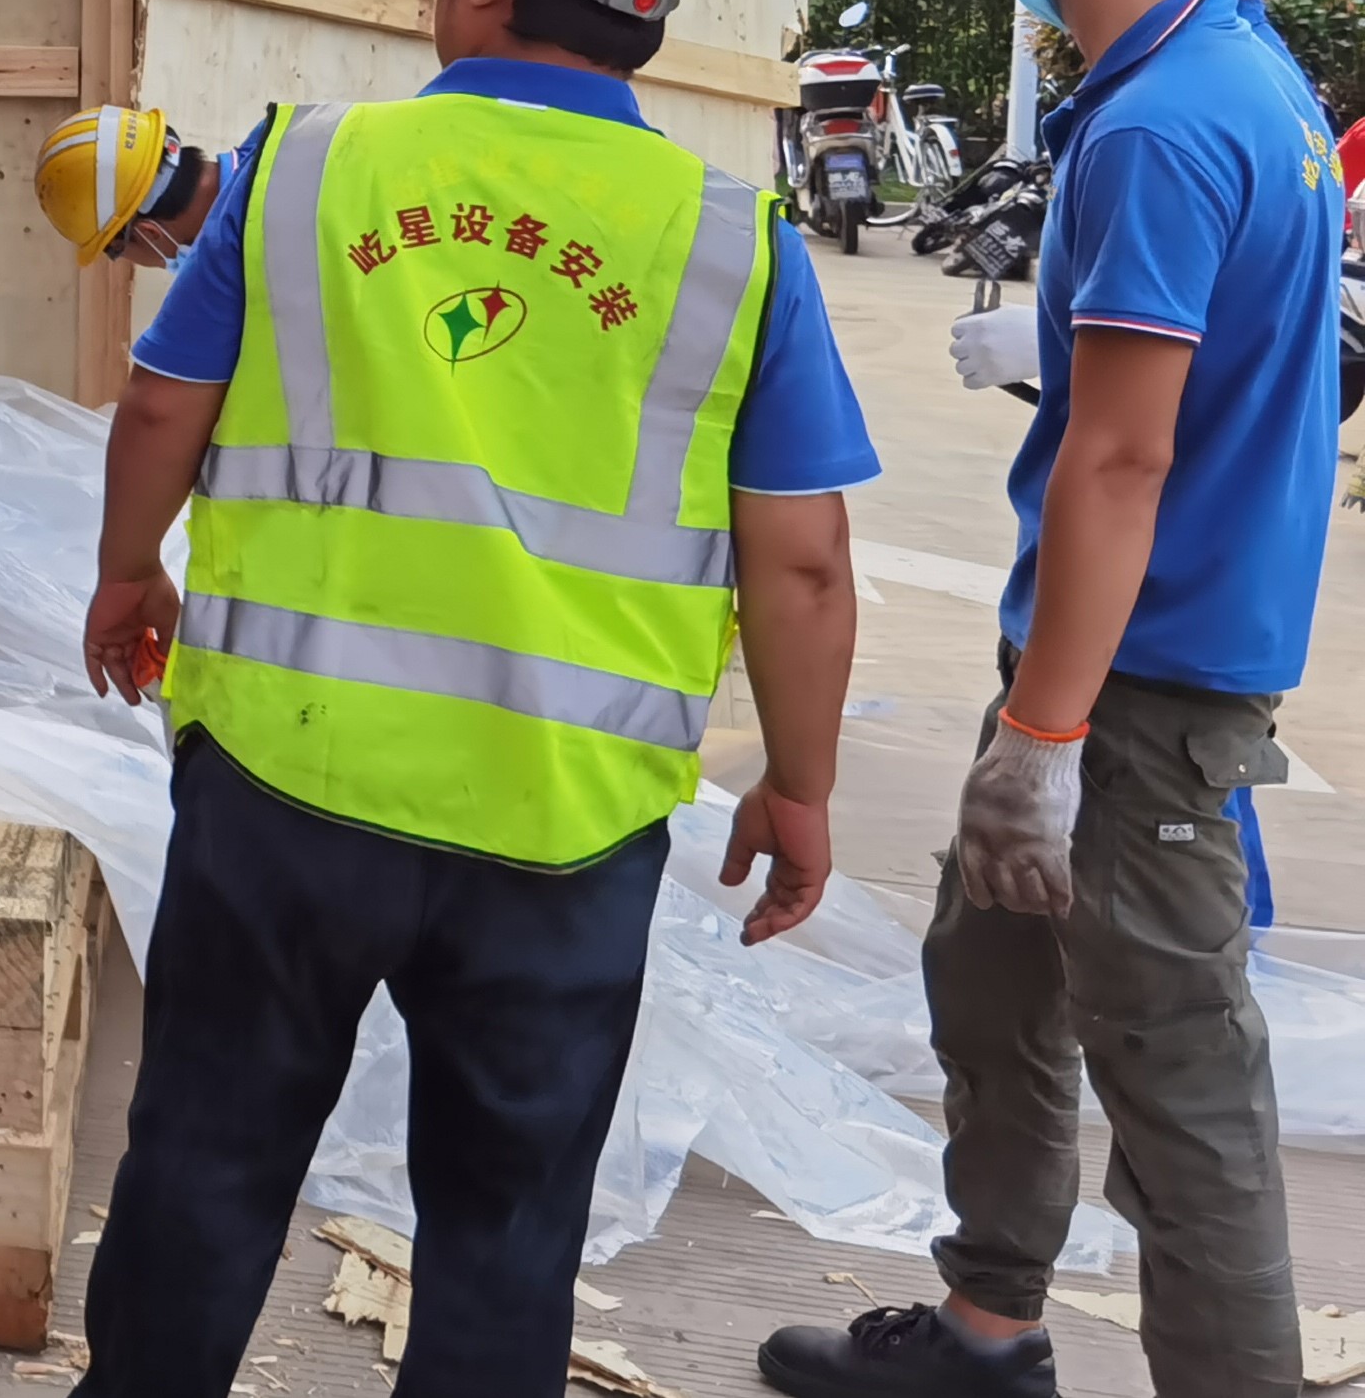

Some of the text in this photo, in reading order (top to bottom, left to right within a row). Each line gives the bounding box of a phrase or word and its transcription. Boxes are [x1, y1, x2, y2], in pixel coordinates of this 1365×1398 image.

[347, 202, 639, 332] 屹星设备安装
